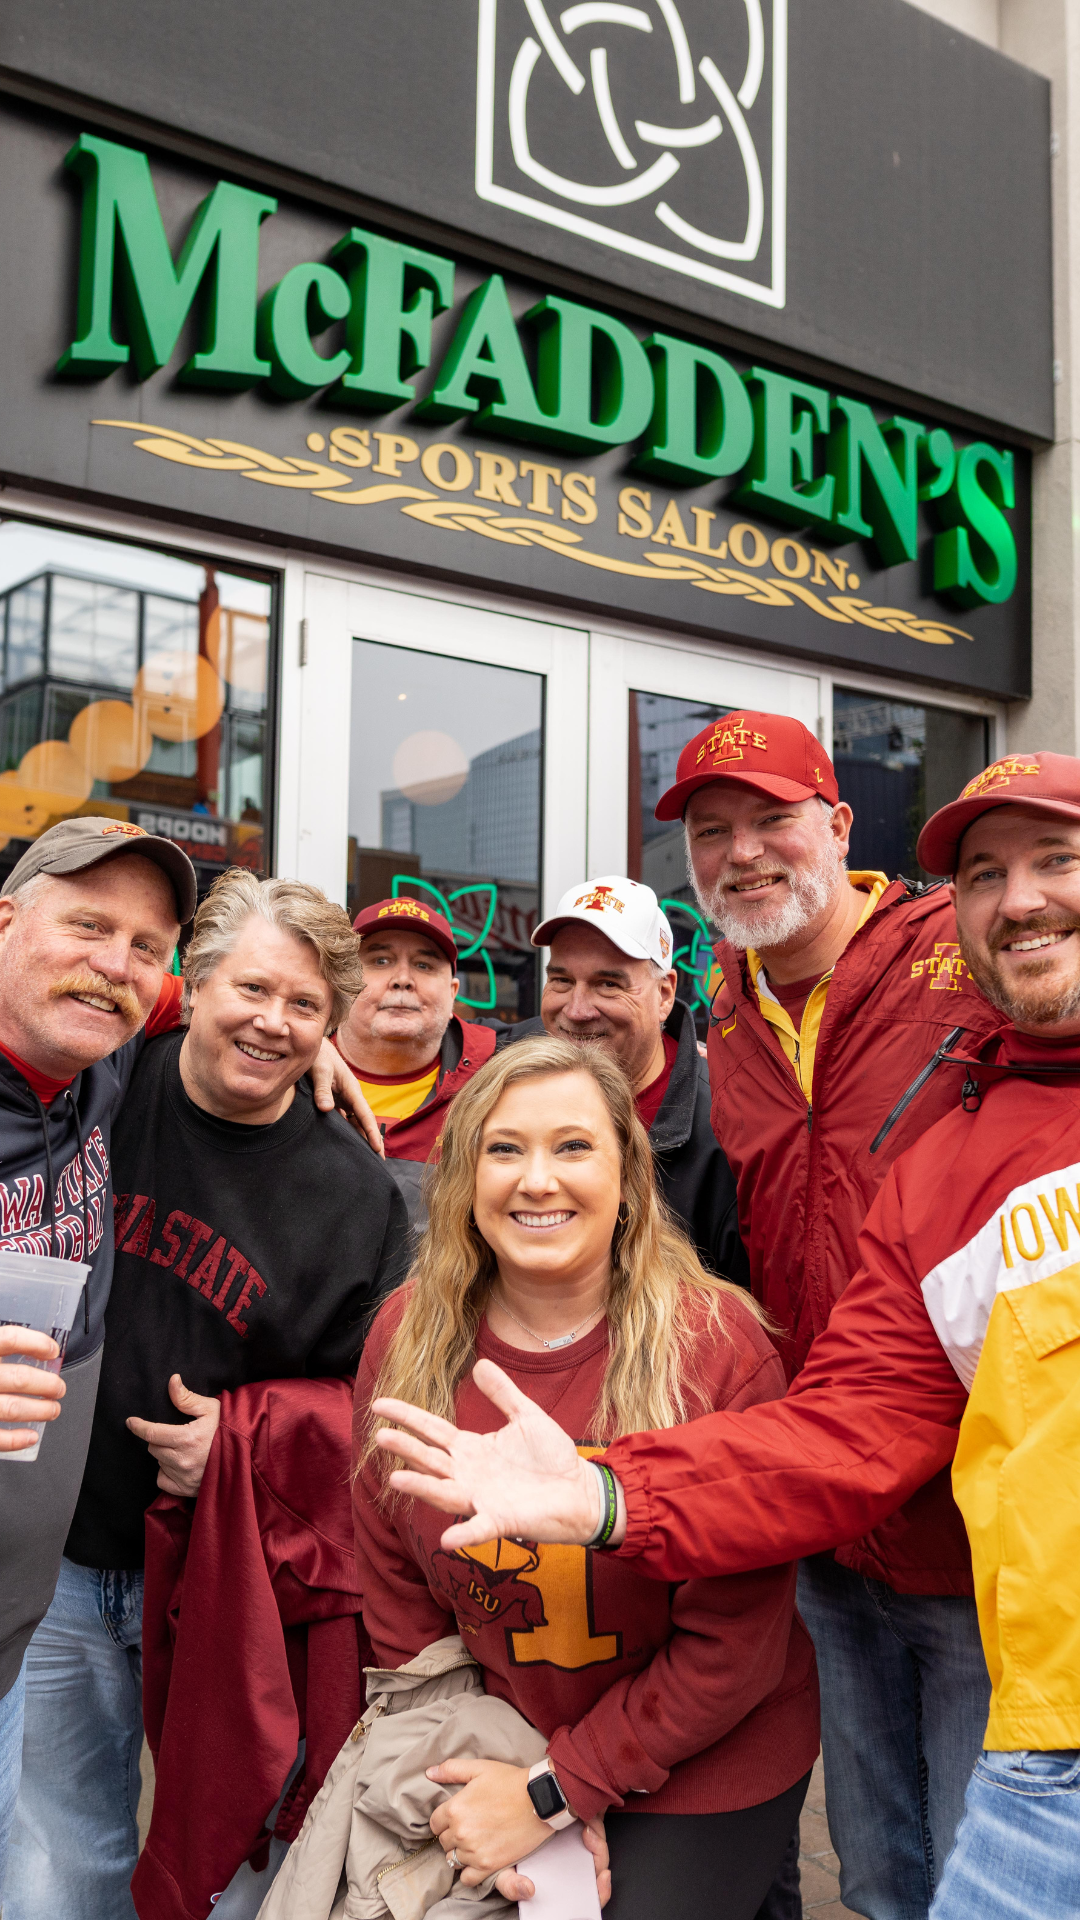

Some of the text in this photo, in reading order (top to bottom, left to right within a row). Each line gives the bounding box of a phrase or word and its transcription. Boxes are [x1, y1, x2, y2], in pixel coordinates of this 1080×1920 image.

[696, 729, 767, 766] STATE
[963, 764, 1040, 799] STATE
[377, 902, 430, 922] STATE
[573, 893, 625, 914] STATE
[910, 957, 974, 981] STAT
[149, 1209, 268, 1339] STATE
[468, 1580, 500, 1613] ISU
